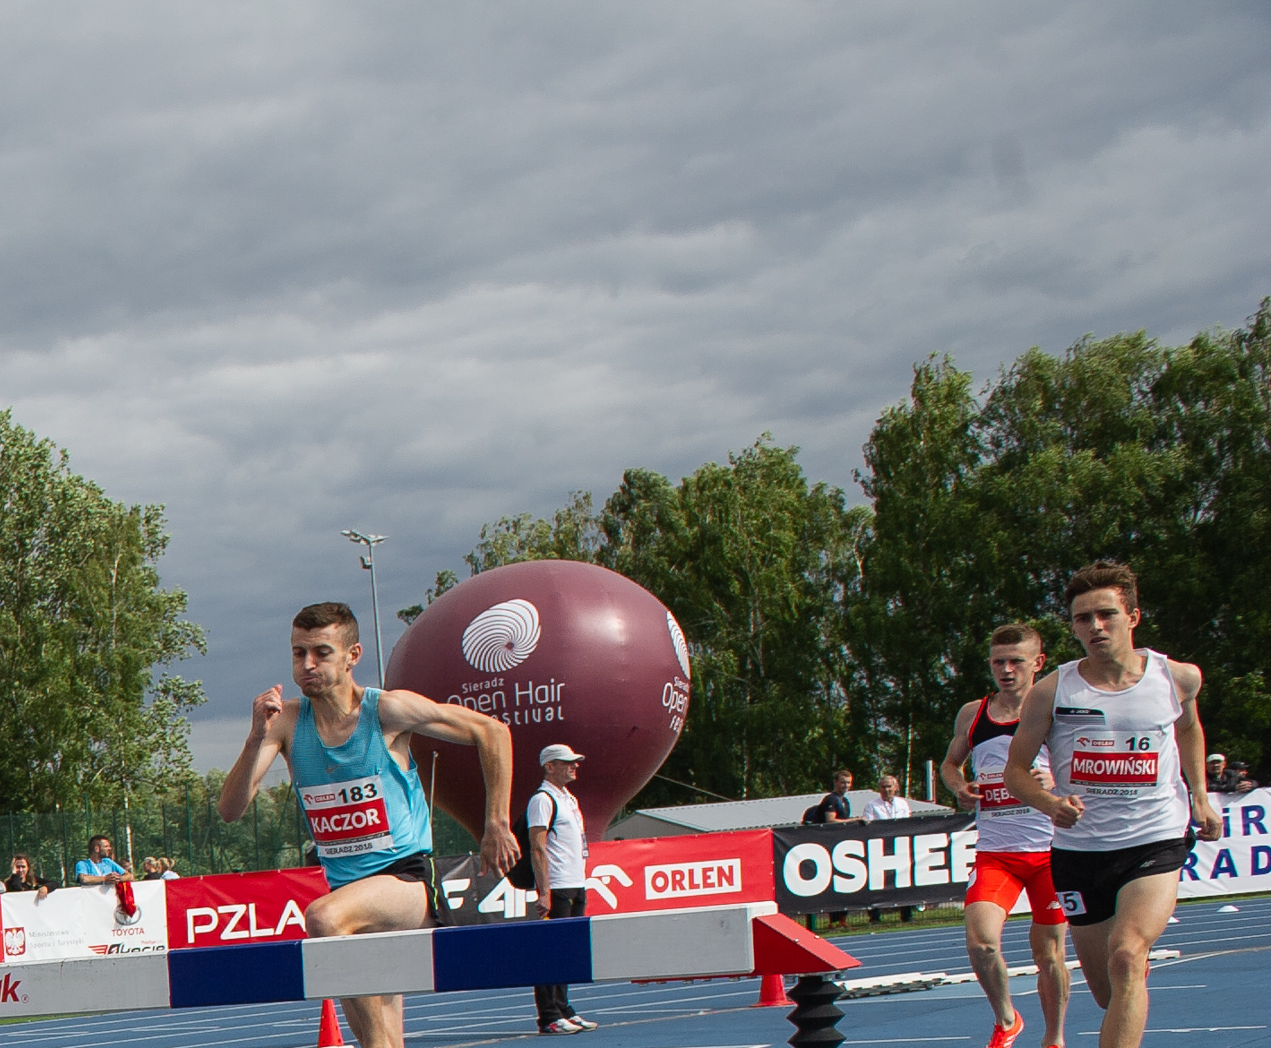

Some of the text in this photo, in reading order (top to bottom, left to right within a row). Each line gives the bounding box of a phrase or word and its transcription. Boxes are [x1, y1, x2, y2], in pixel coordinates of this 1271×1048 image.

[461, 677, 505, 695] Sieradz
[514, 678, 565, 706] Hair
[1125, 736, 1151, 751] 16
[1073, 757, 1156, 776] MROWIŃSKI
[338, 783, 378, 804] 183
[984, 787, 1016, 804] DĘB
[310, 808, 382, 834] KACZOR
[650, 864, 735, 894] ORLEN
[1062, 892, 1078, 912] 5
[111, 927, 145, 937] TOYOTA
